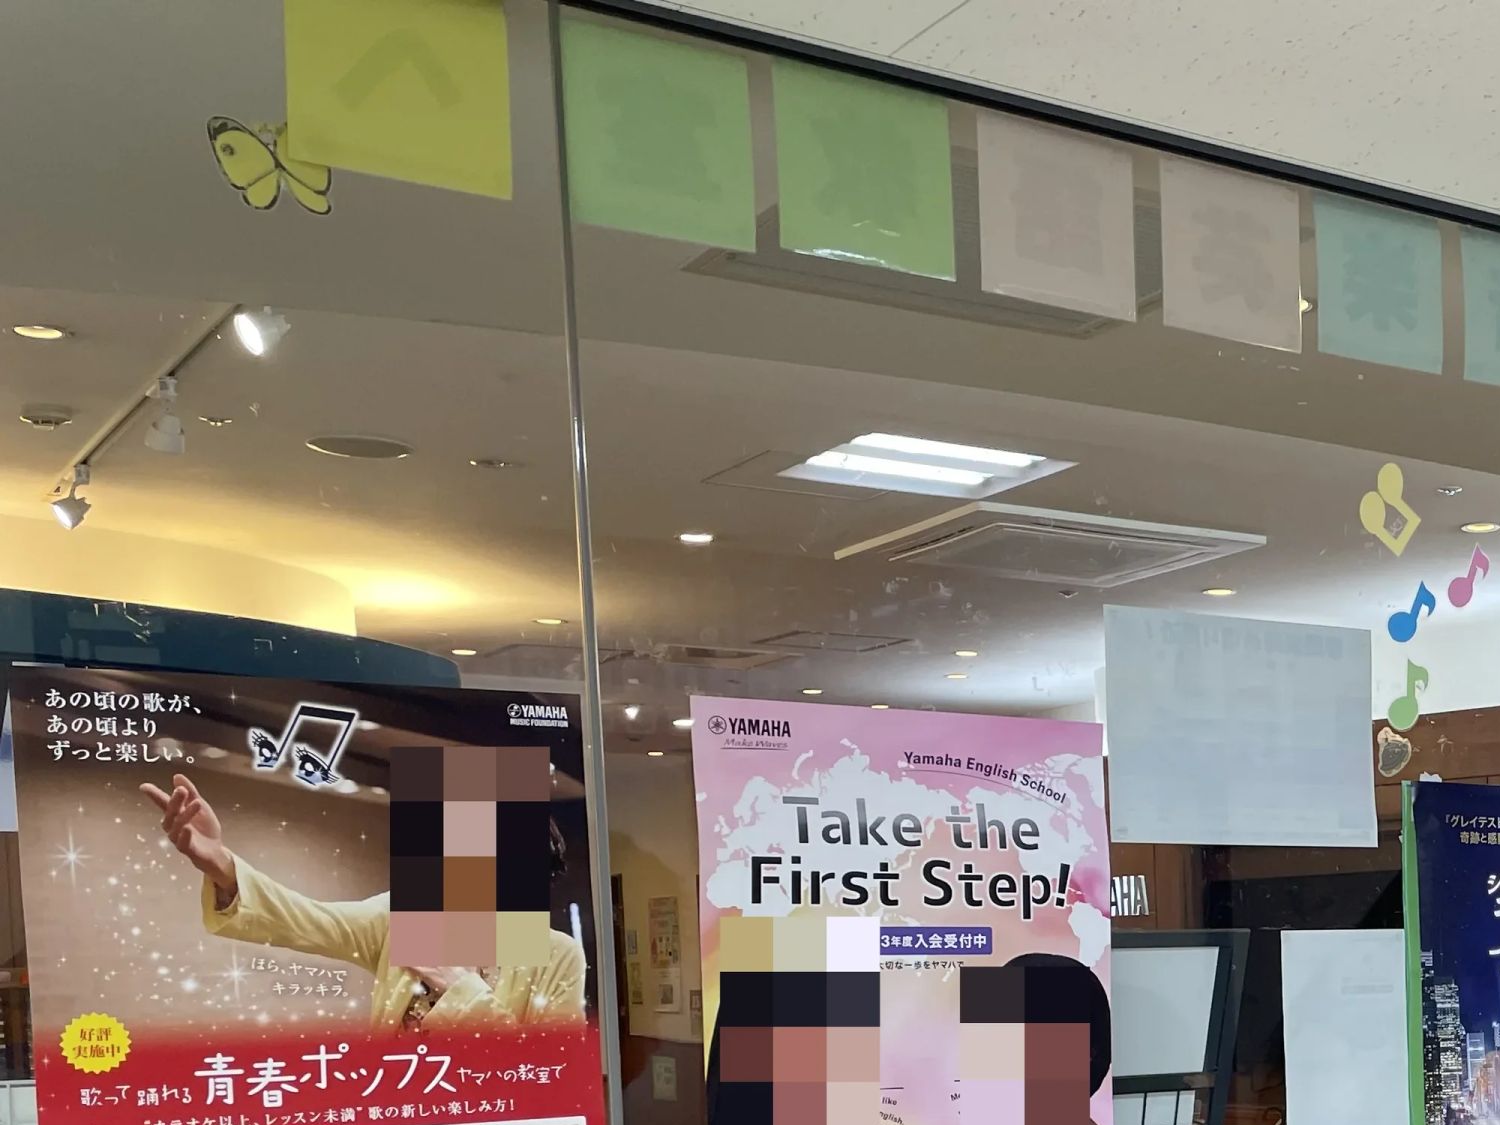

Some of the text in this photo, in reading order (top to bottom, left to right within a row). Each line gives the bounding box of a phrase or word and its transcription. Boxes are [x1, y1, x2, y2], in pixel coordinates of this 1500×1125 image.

[45, 688, 201, 714] あの頃の歌が、
[521, 704, 568, 719] YAMAHA
[47, 714, 157, 738] あの頃より
[728, 717, 791, 738] YAMAHA
[46, 740, 195, 764] ずっと楽しい。
[723, 738, 789, 749] Make Waves
[904, 752, 1067, 804] Yamaha English School
[782, 796, 1041, 851] Take the
[750, 855, 1071, 920] First Step!
[251, 957, 348, 982] ほら、ヤマハで
[272, 982, 349, 998] キラッキラ。
[79, 1027, 113, 1042] 好評
[73, 1043, 121, 1059] 実施中
[194, 1043, 457, 1108] 青春ポップス
[456, 1063, 567, 1087] ヤマハの教室で
